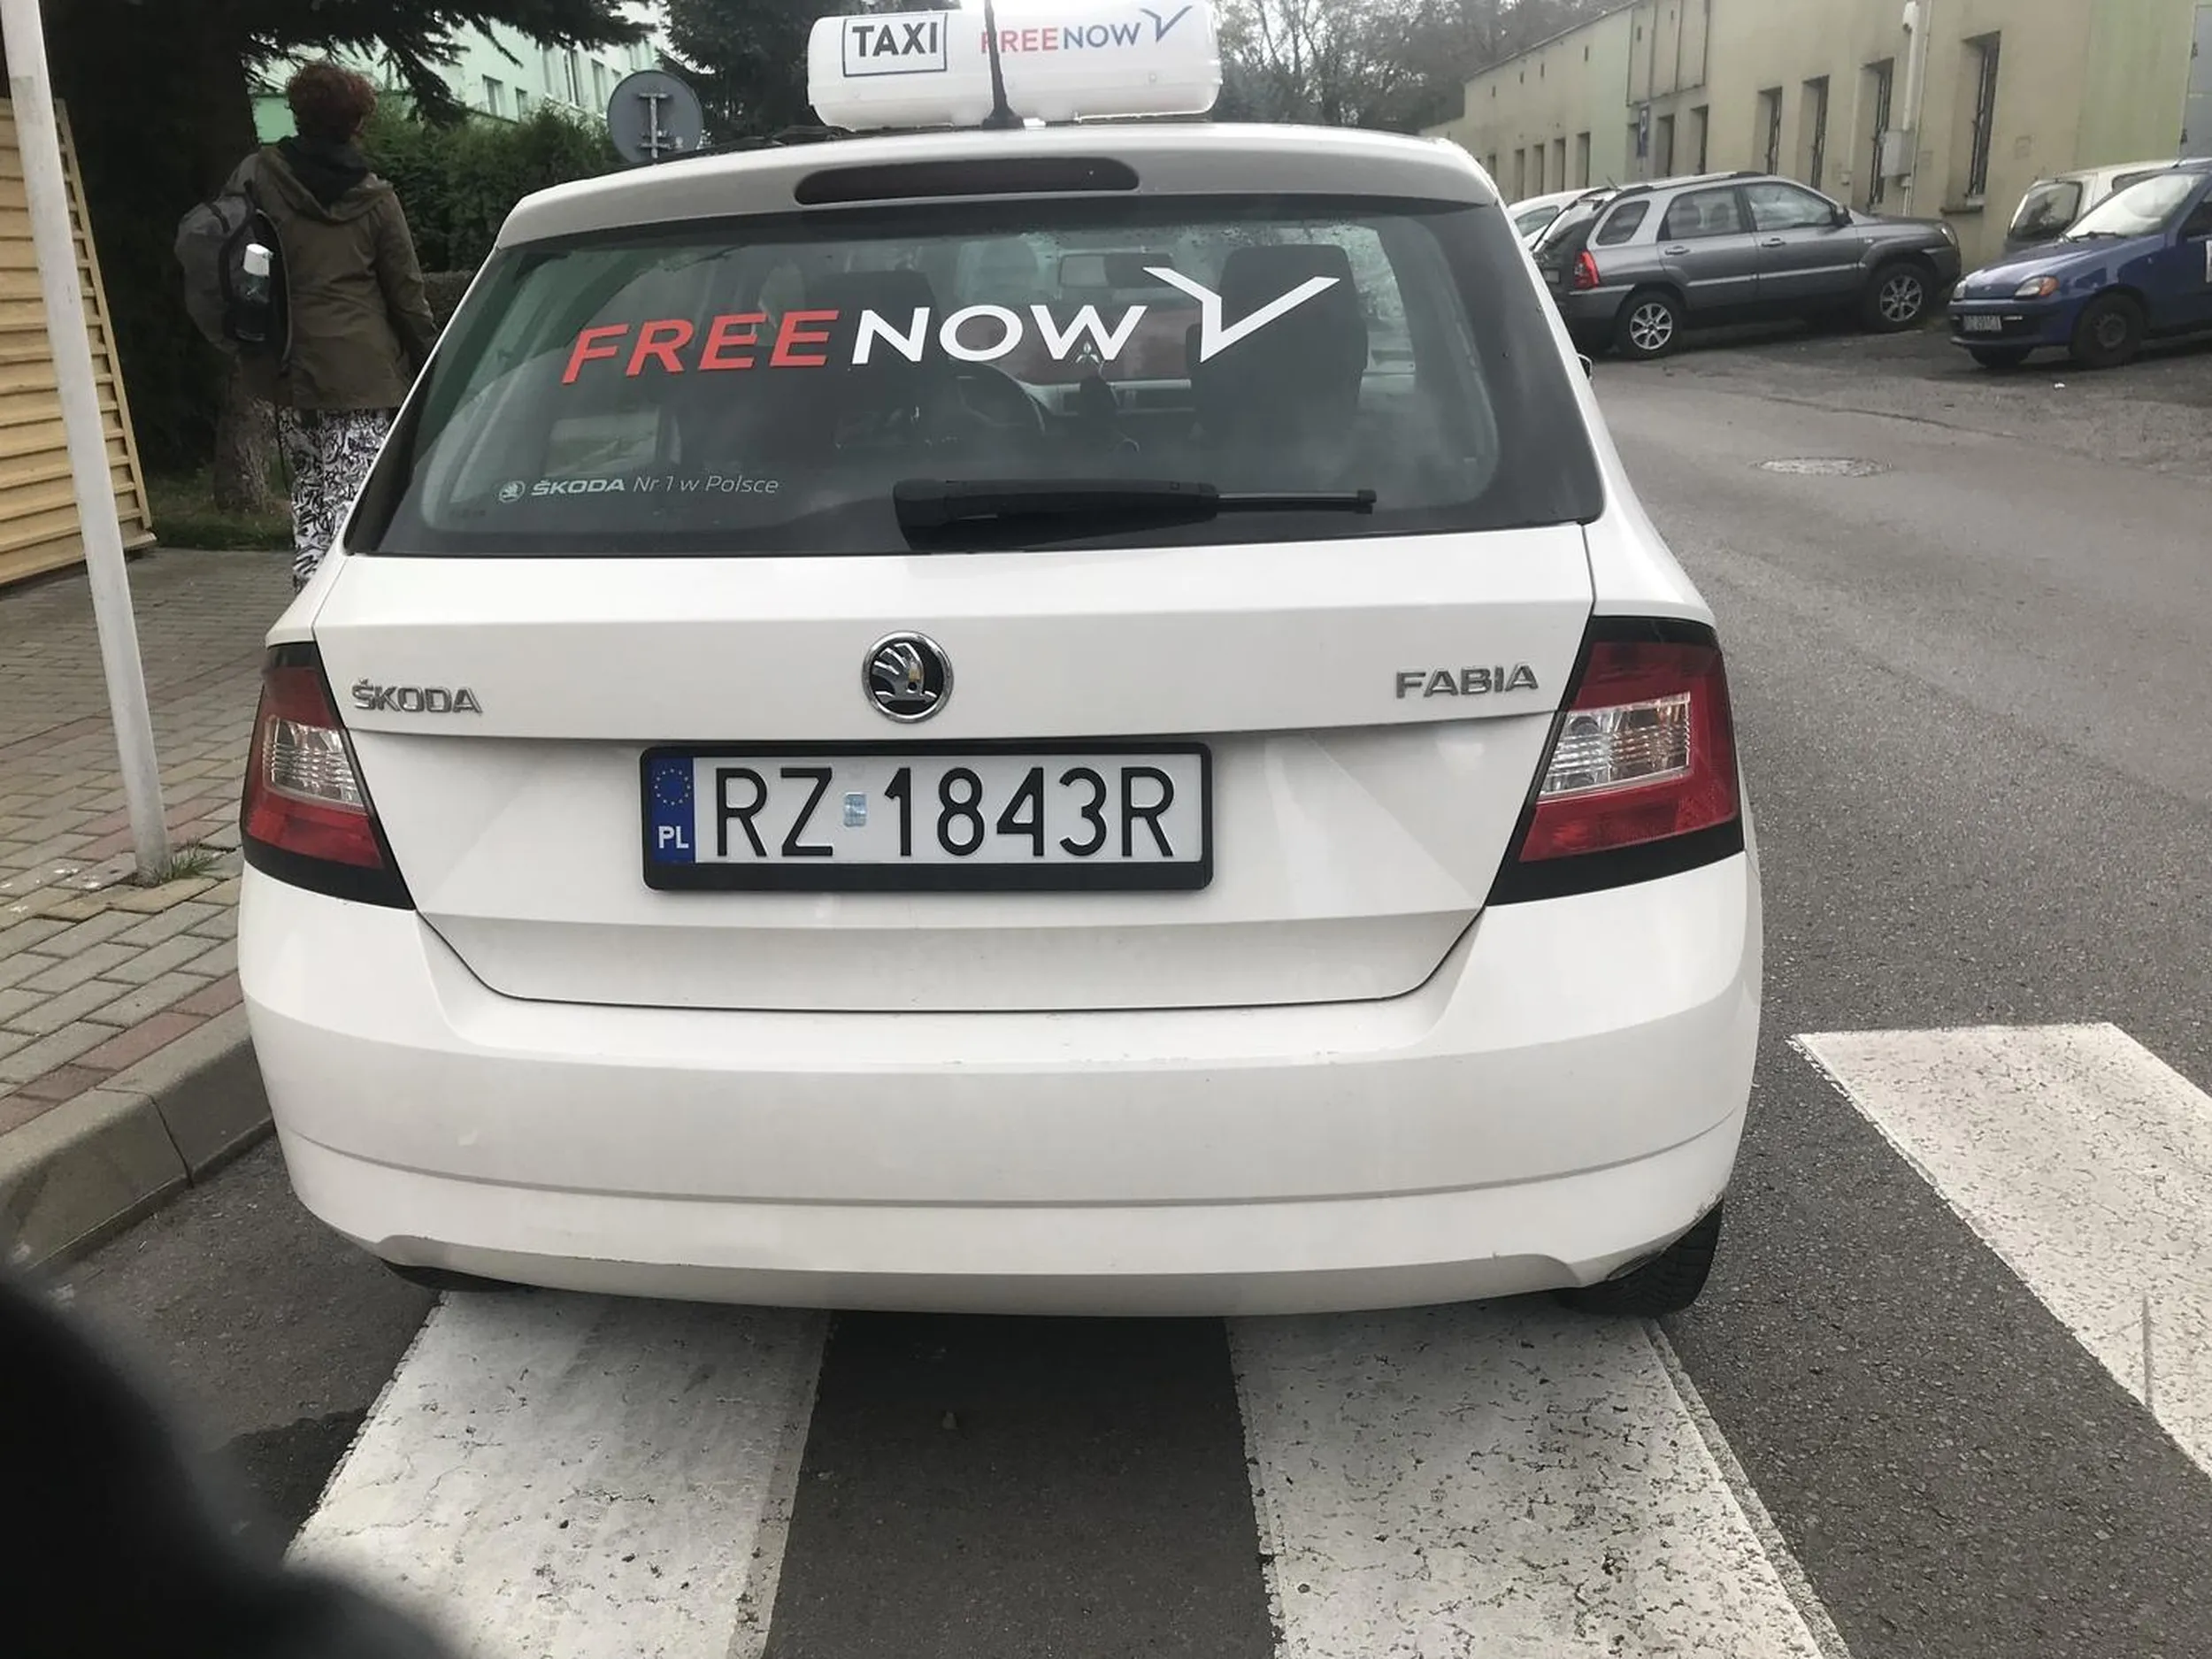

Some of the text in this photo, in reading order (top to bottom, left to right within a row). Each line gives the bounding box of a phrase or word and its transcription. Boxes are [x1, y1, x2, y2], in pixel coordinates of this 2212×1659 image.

[852, 22, 938, 58] TAXI
[531, 475, 779, 496] ŠKODA Nr 1 w Polsce
[351, 679, 483, 714] ŠKODA
[1395, 664, 1539, 699] FABIA
[715, 765, 1175, 858] RZ 1843R
[658, 826, 690, 849] PL
